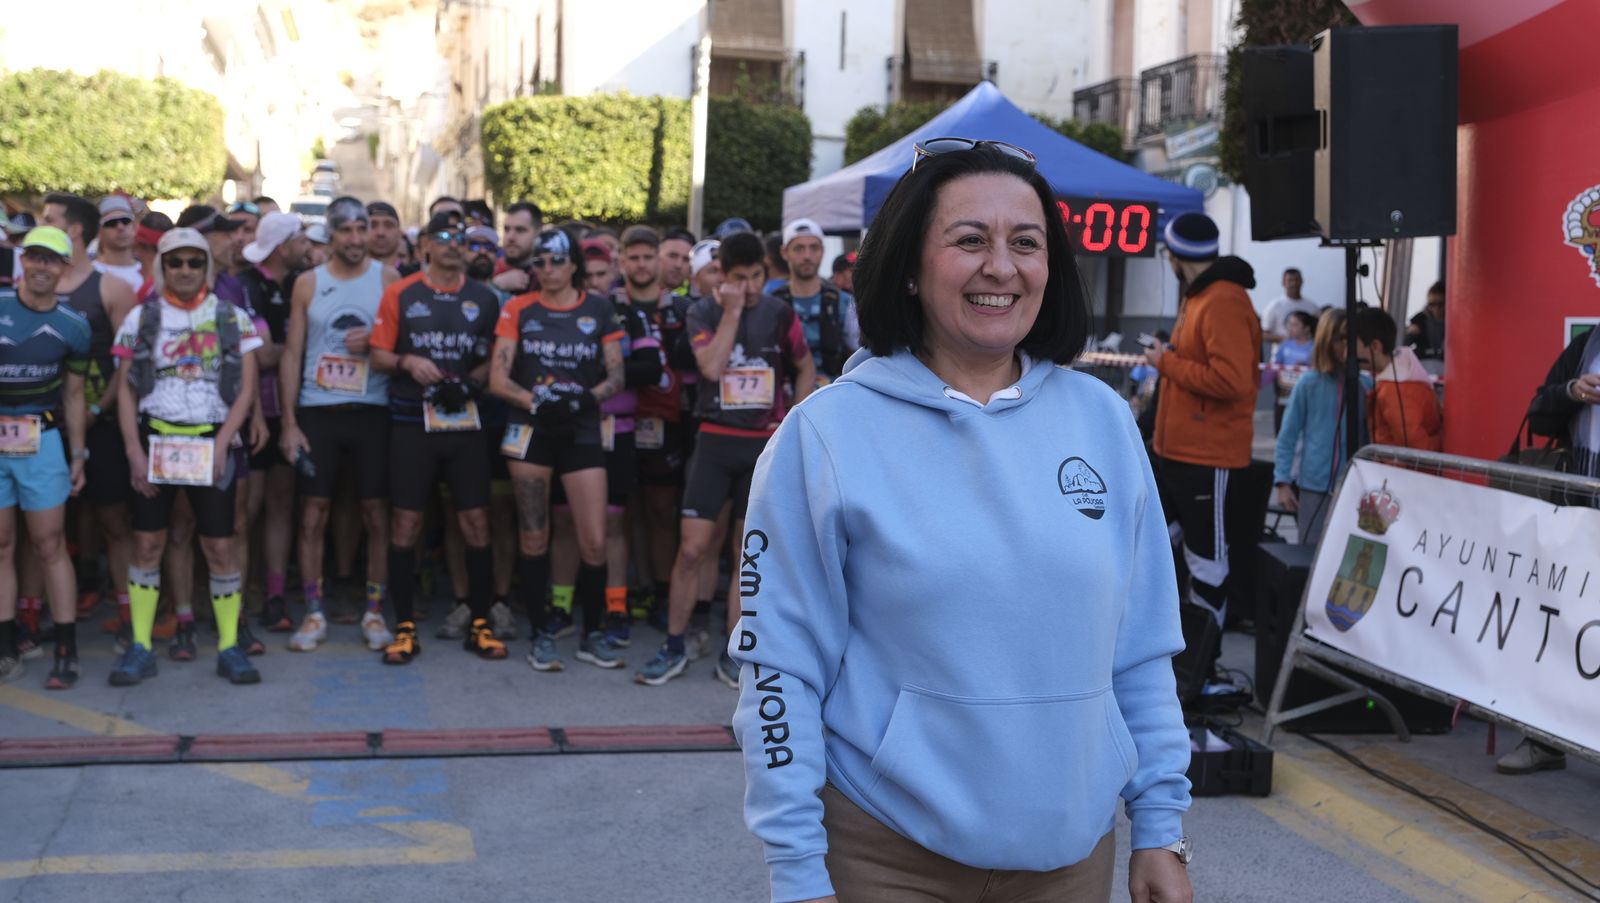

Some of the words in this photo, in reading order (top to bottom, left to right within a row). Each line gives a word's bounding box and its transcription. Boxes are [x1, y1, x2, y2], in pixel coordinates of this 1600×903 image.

[326, 362, 357, 377] 117
[737, 377, 759, 390] 77
[1396, 566, 1600, 680] CANTO
